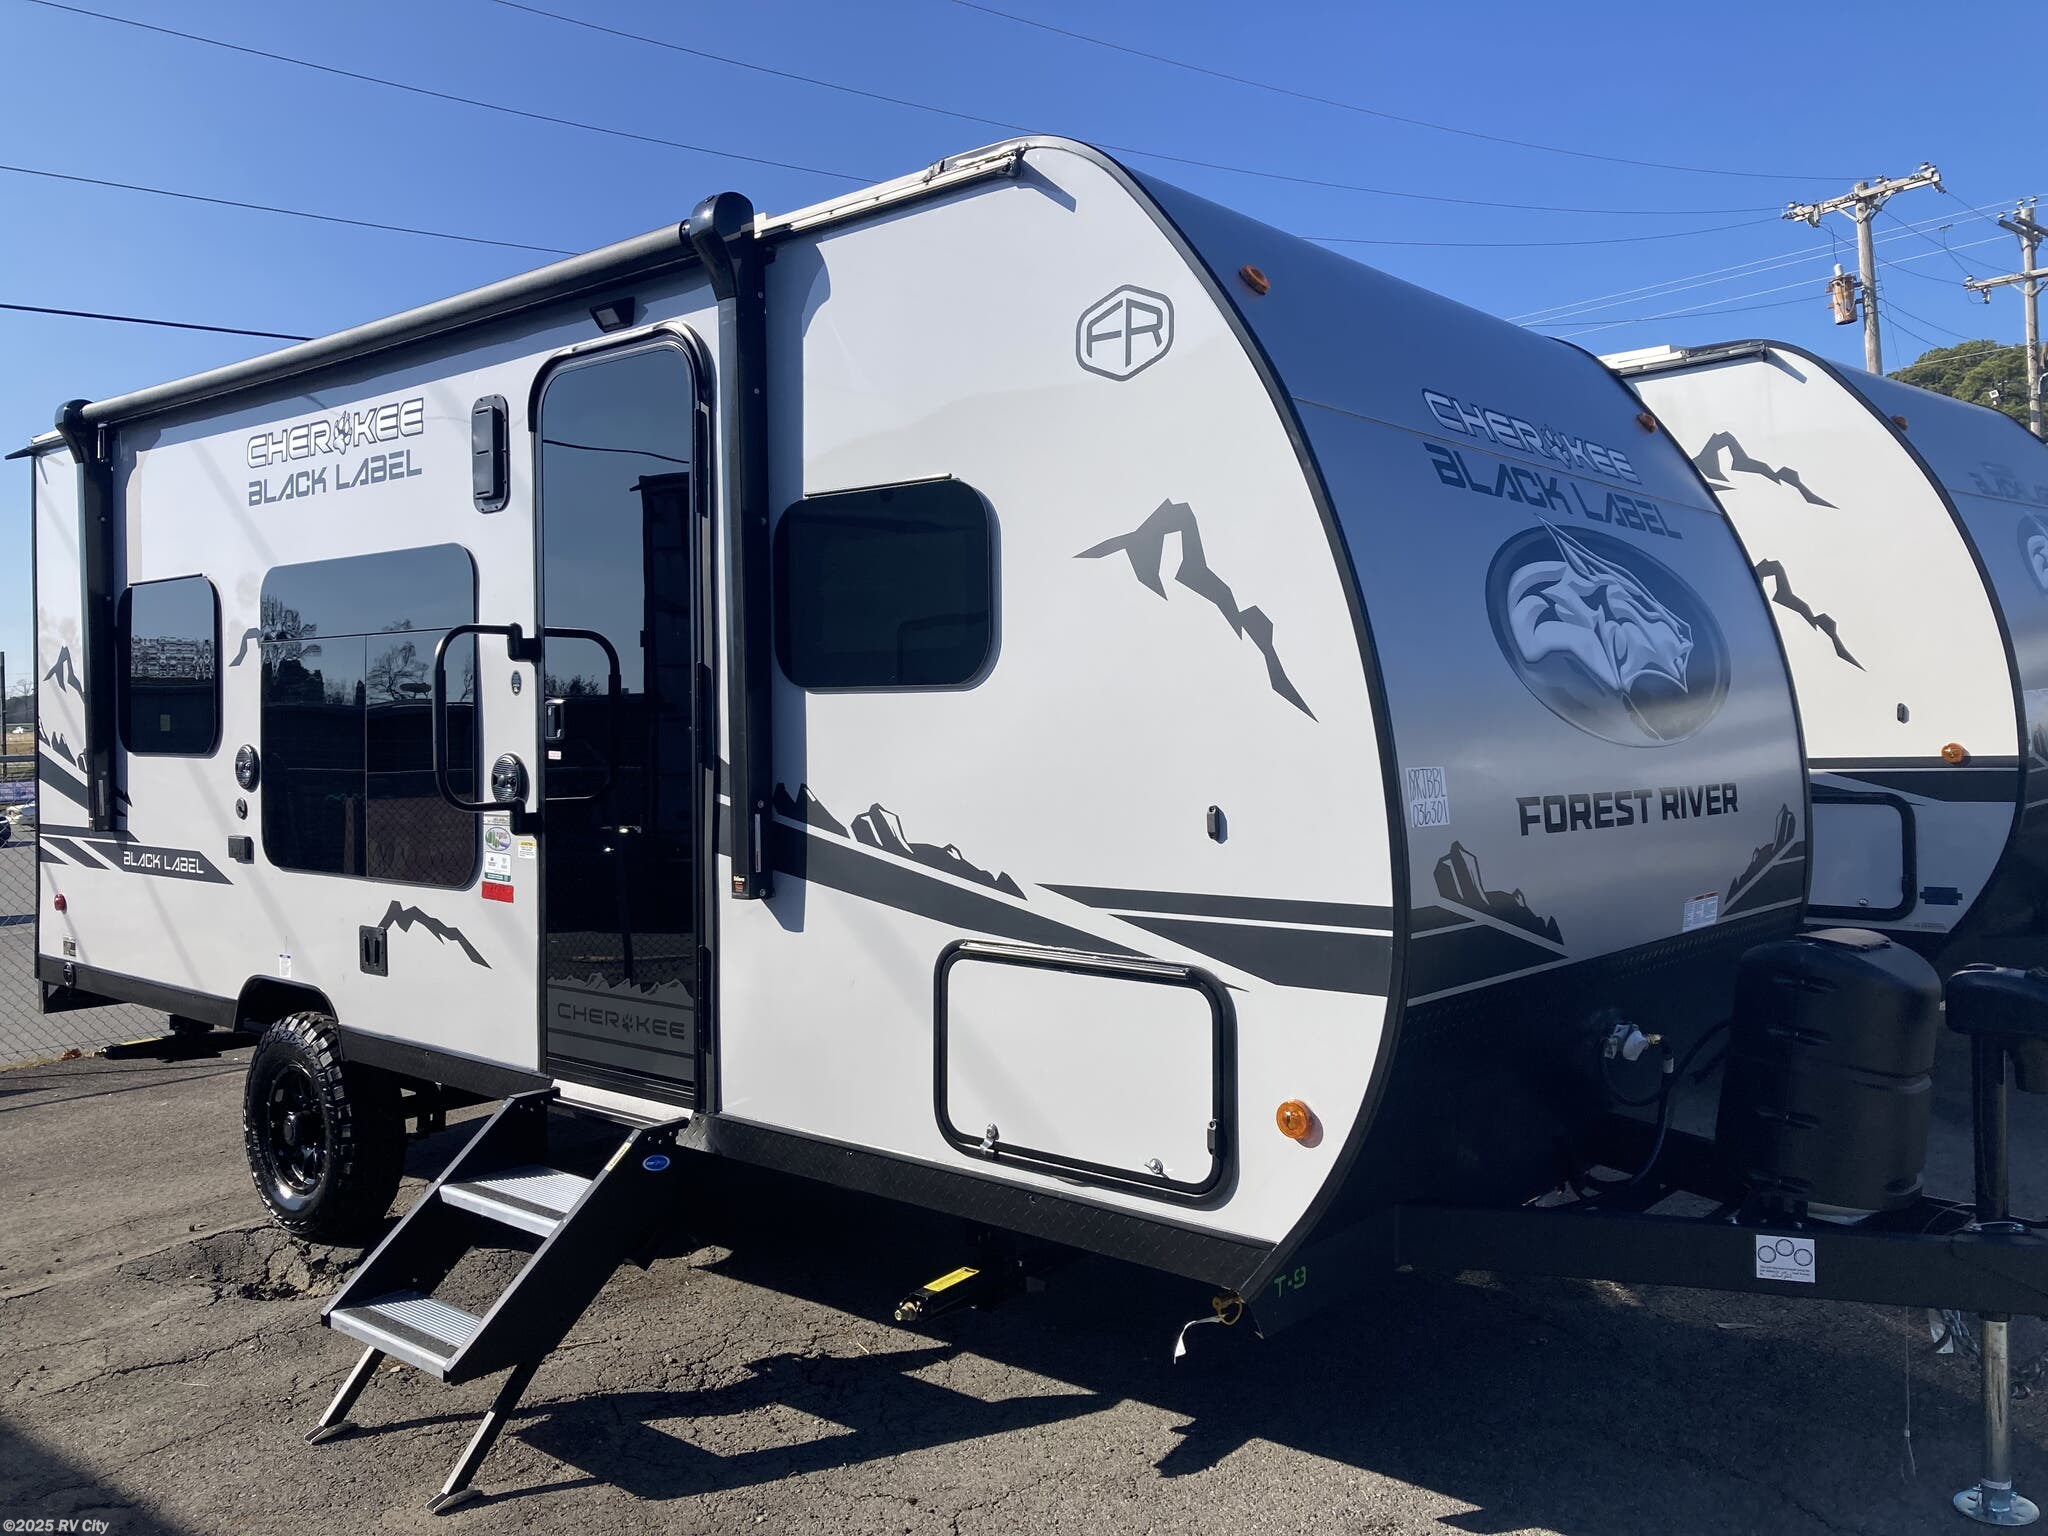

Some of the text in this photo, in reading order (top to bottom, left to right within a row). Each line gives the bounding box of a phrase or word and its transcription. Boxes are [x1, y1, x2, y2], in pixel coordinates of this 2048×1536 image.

[248, 449, 423, 507] BLACK LABEL
[1423, 442, 1683, 540] BLACK LABEL
[1515, 782, 1739, 837] FOREST RIVER
[123, 851, 205, 874] BLACK LABEL
